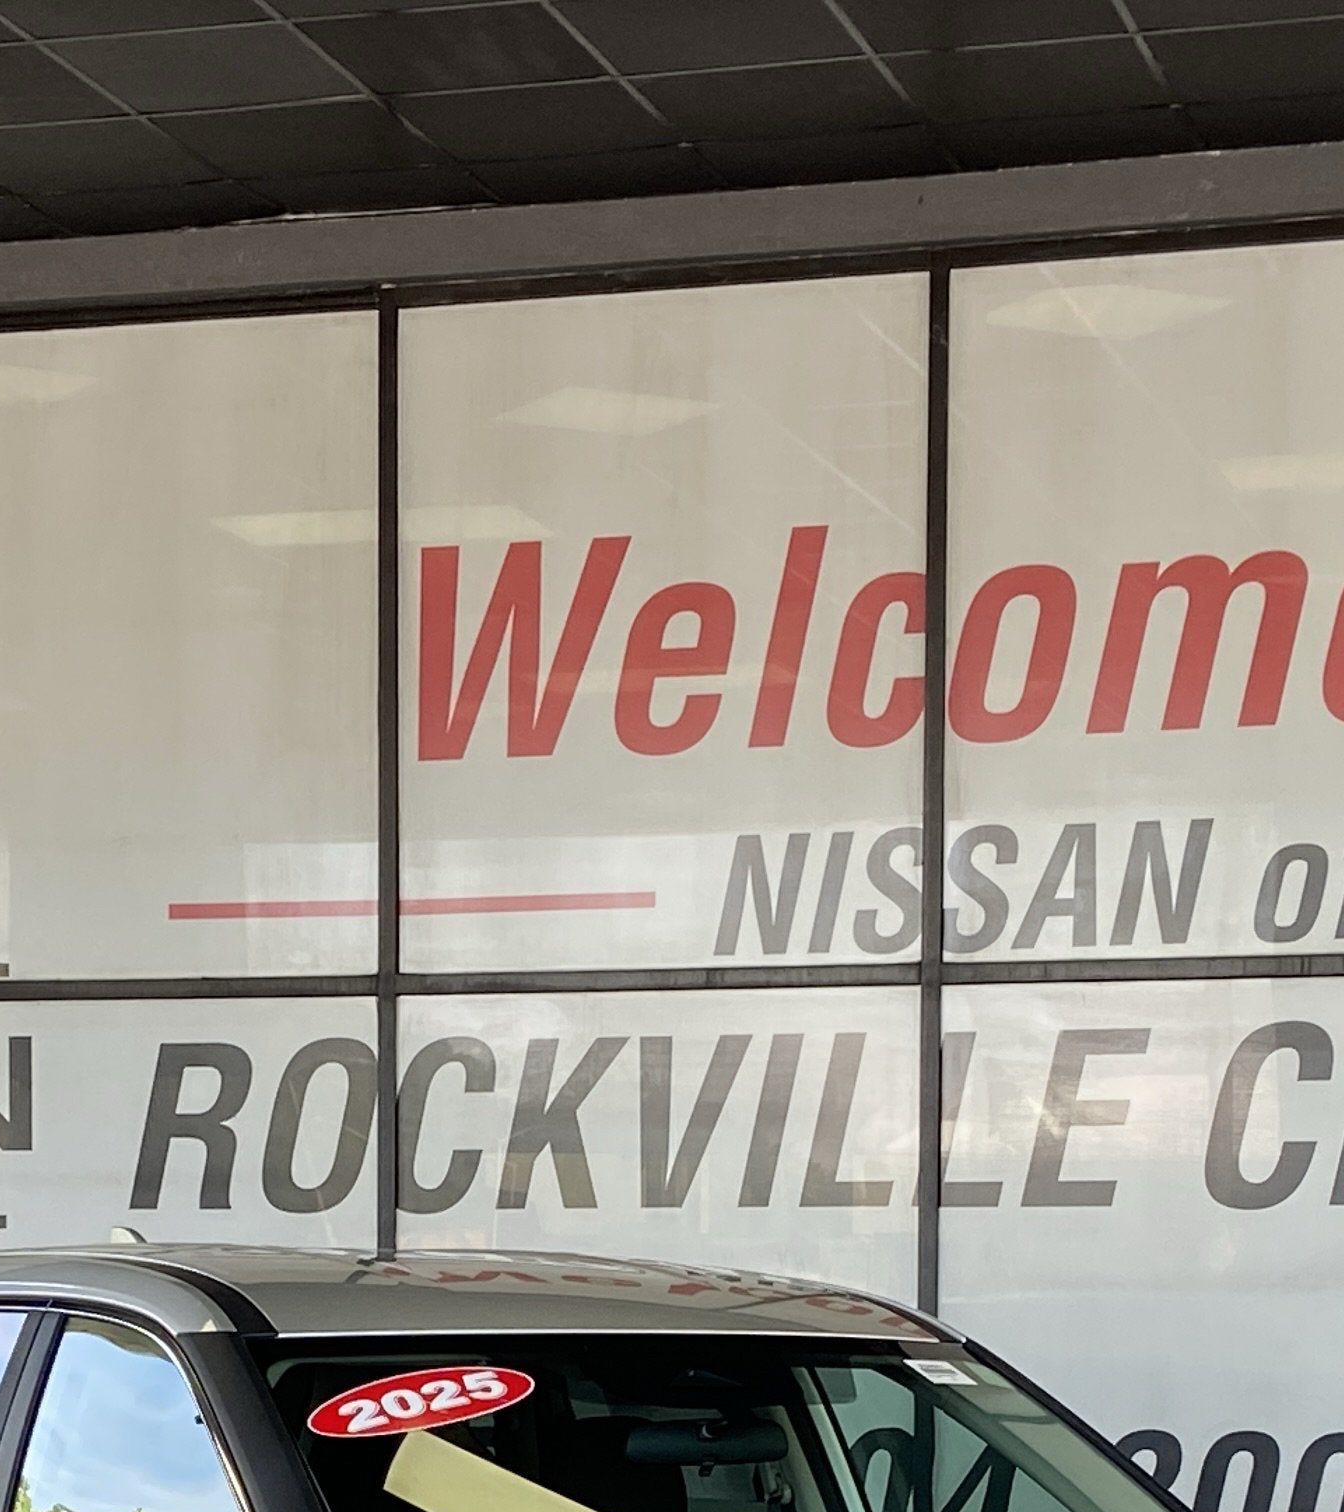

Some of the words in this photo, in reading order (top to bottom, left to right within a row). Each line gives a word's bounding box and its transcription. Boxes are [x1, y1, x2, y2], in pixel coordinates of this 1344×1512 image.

[712, 817, 1216, 957] NISSAN
[128, 1025, 1152, 1214] ROCKVILLE
[338, 1370, 508, 1434] 2025
